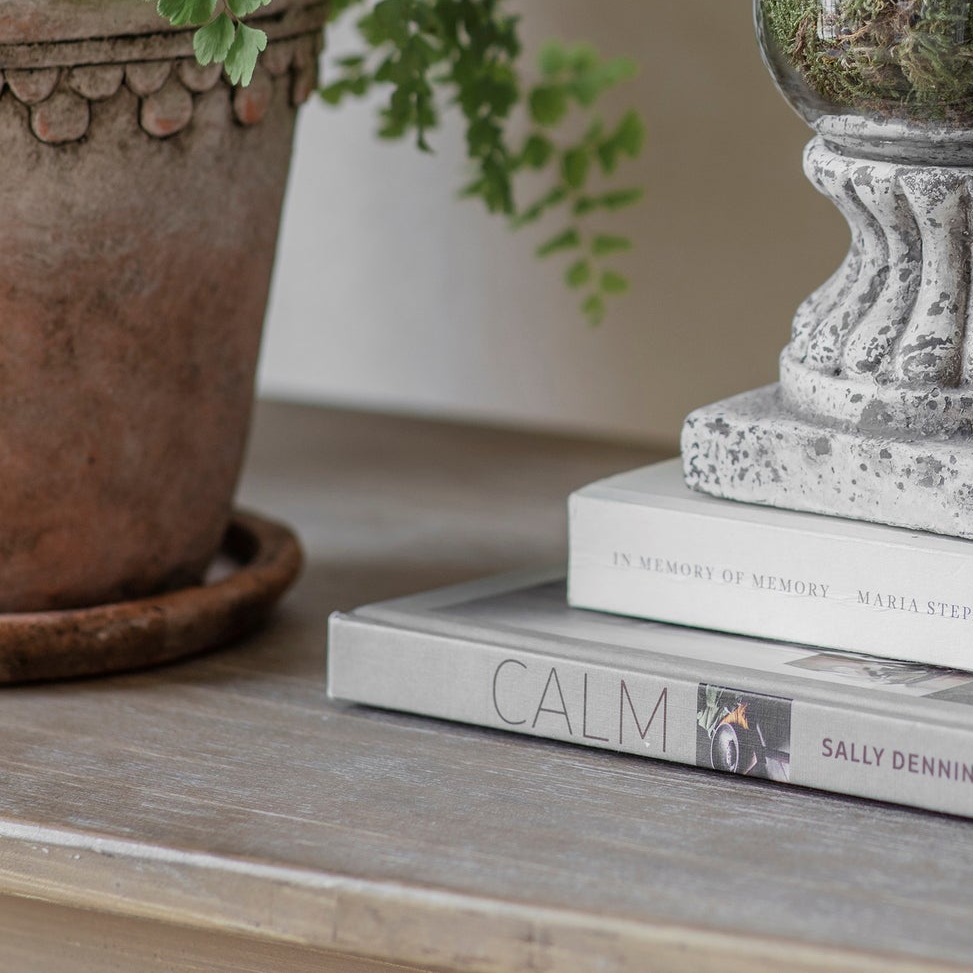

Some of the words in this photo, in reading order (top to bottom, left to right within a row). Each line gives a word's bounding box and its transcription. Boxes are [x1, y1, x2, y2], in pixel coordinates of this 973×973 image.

[613, 551, 631, 567] IN
[640, 555, 715, 581] MEMORY
[722, 569, 745, 585] OF
[751, 573, 830, 598] MEMORY
[857, 590, 919, 613] MARIA
[492, 658, 668, 753] CALM
[821, 738, 885, 767] SALLY
